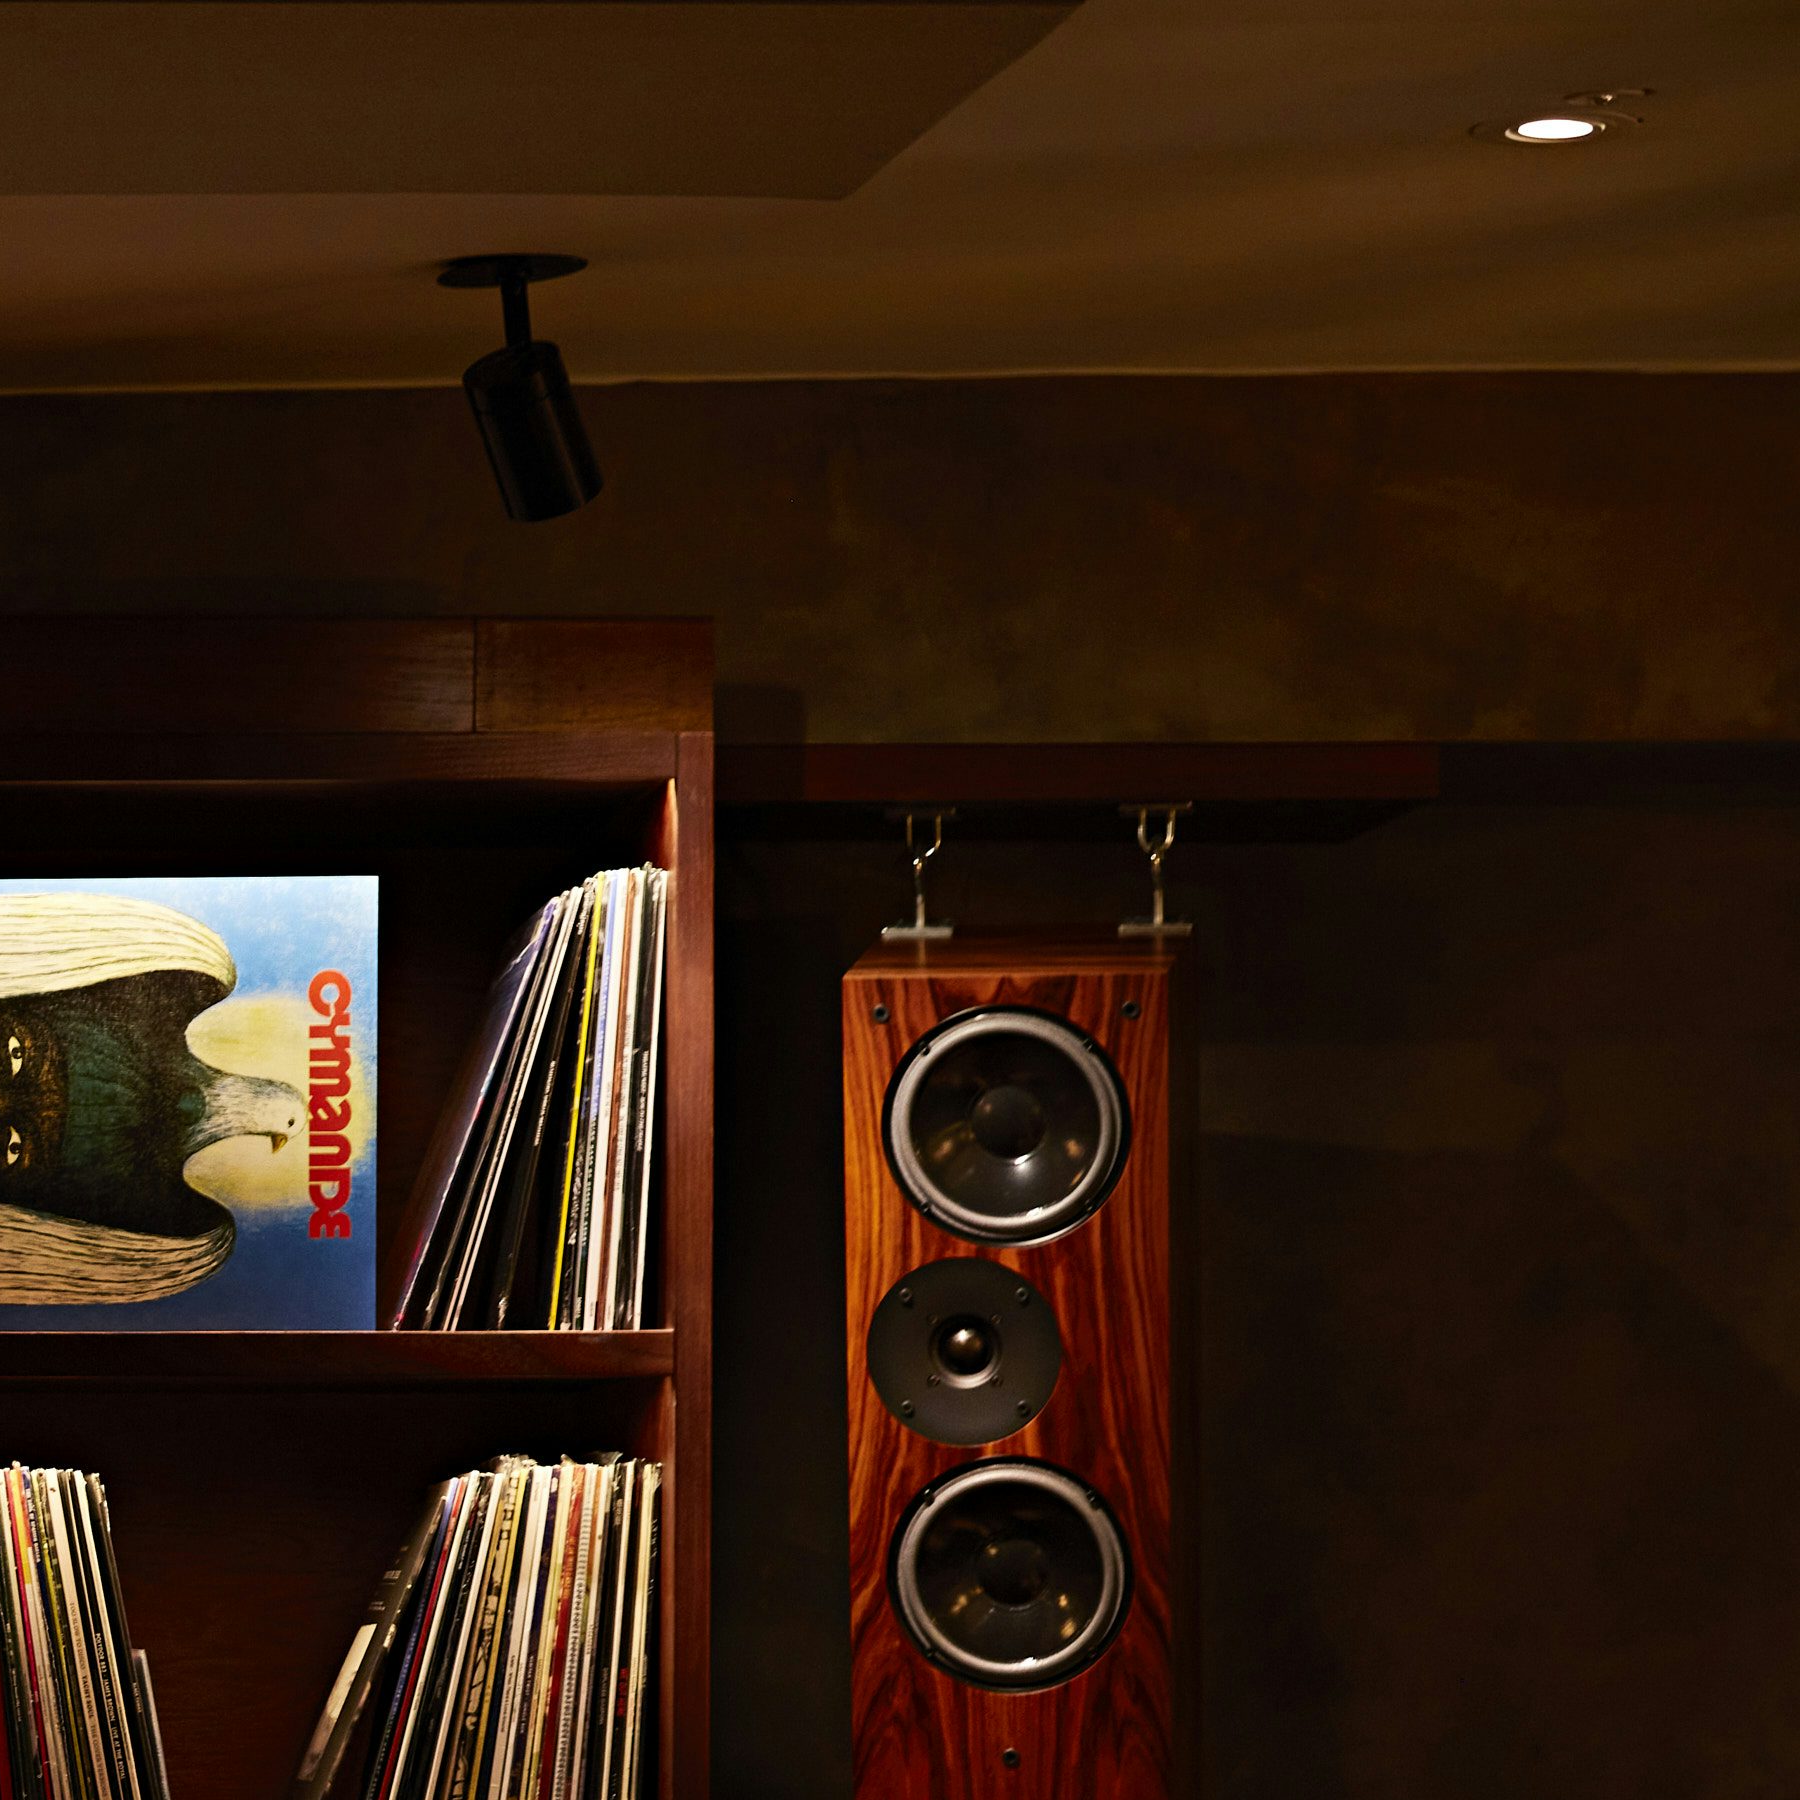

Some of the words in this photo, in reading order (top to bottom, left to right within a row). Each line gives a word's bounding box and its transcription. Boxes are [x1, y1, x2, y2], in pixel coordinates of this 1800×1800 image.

[74, 1637, 82, 1647] TO
[94, 1632, 105, 1659] POLYDOR
[76, 1648, 86, 1669] DISCO
[81, 1675, 91, 1698] YACHT
[102, 1678, 111, 1696] JAMES
[85, 1700, 94, 1718] SOUL
[105, 1698, 116, 1721] BROWN
[110, 1726, 119, 1738] LIVE
[114, 1748, 123, 1759] THE
[116, 1760, 126, 1779] ROYAL
